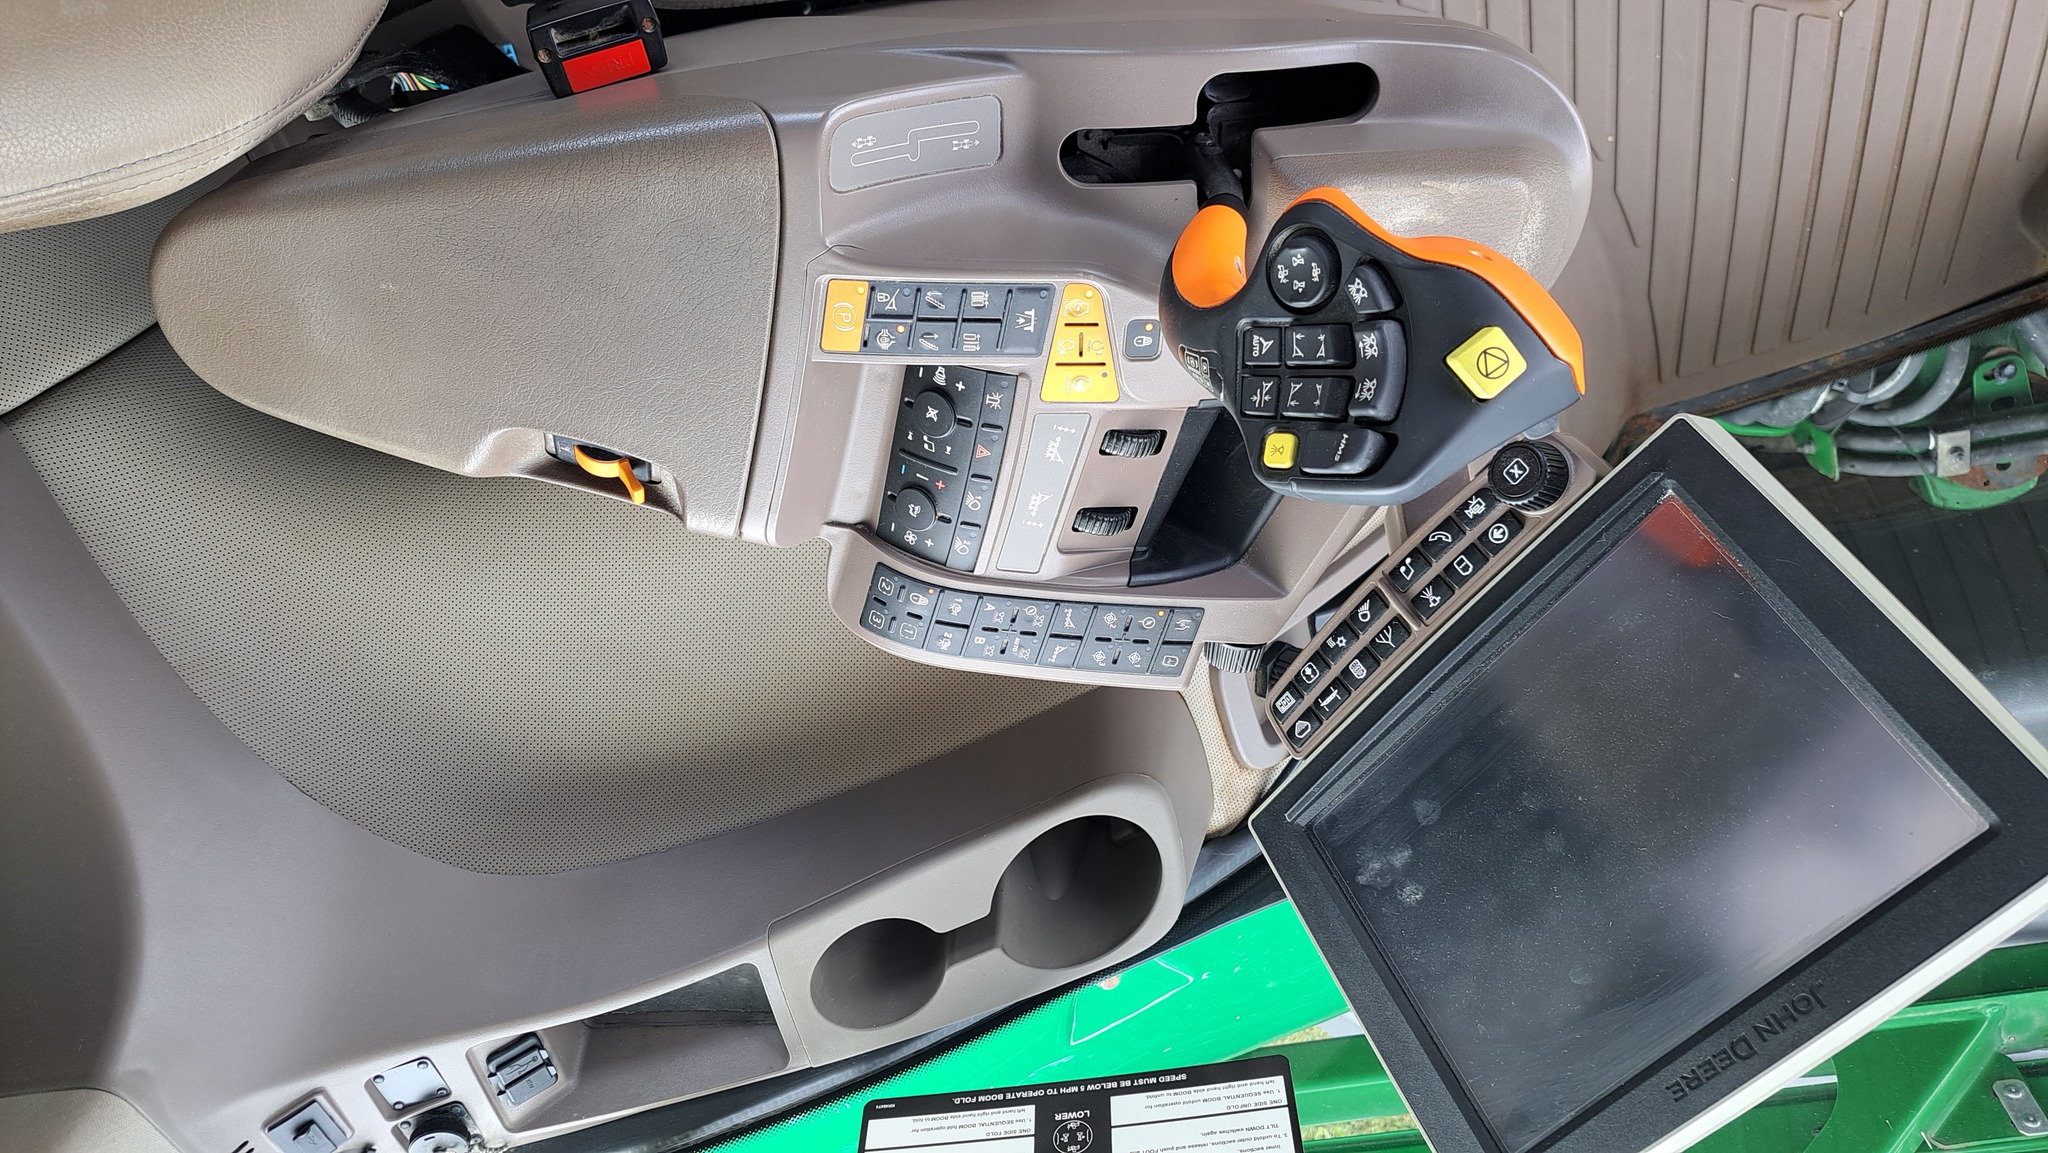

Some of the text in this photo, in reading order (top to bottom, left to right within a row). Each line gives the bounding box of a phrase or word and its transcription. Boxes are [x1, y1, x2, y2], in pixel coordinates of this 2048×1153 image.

[838, 312, 852, 322] P
[882, 582, 891, 590] 2
[984, 602, 996, 611] A
[872, 615, 882, 624] 3
[974, 636, 986, 644] B
[1012, 637, 1020, 652] AUTO
[1666, 980, 1828, 1102] JOHN DEERE
[1133, 1077, 1156, 1086] MUST
[1159, 1074, 1187, 1082] SPEED
[1087, 1082, 1117, 1091] BELOW
[978, 1094, 1003, 1102] BOOM
[1006, 1089, 1045, 1100] OPERATE
[1223, 1091, 1261, 1100] SEQUENTIAL
[1054, 1110, 1090, 1120] LOWER
[978, 1120, 1014, 1128] SEQUENTIAL
